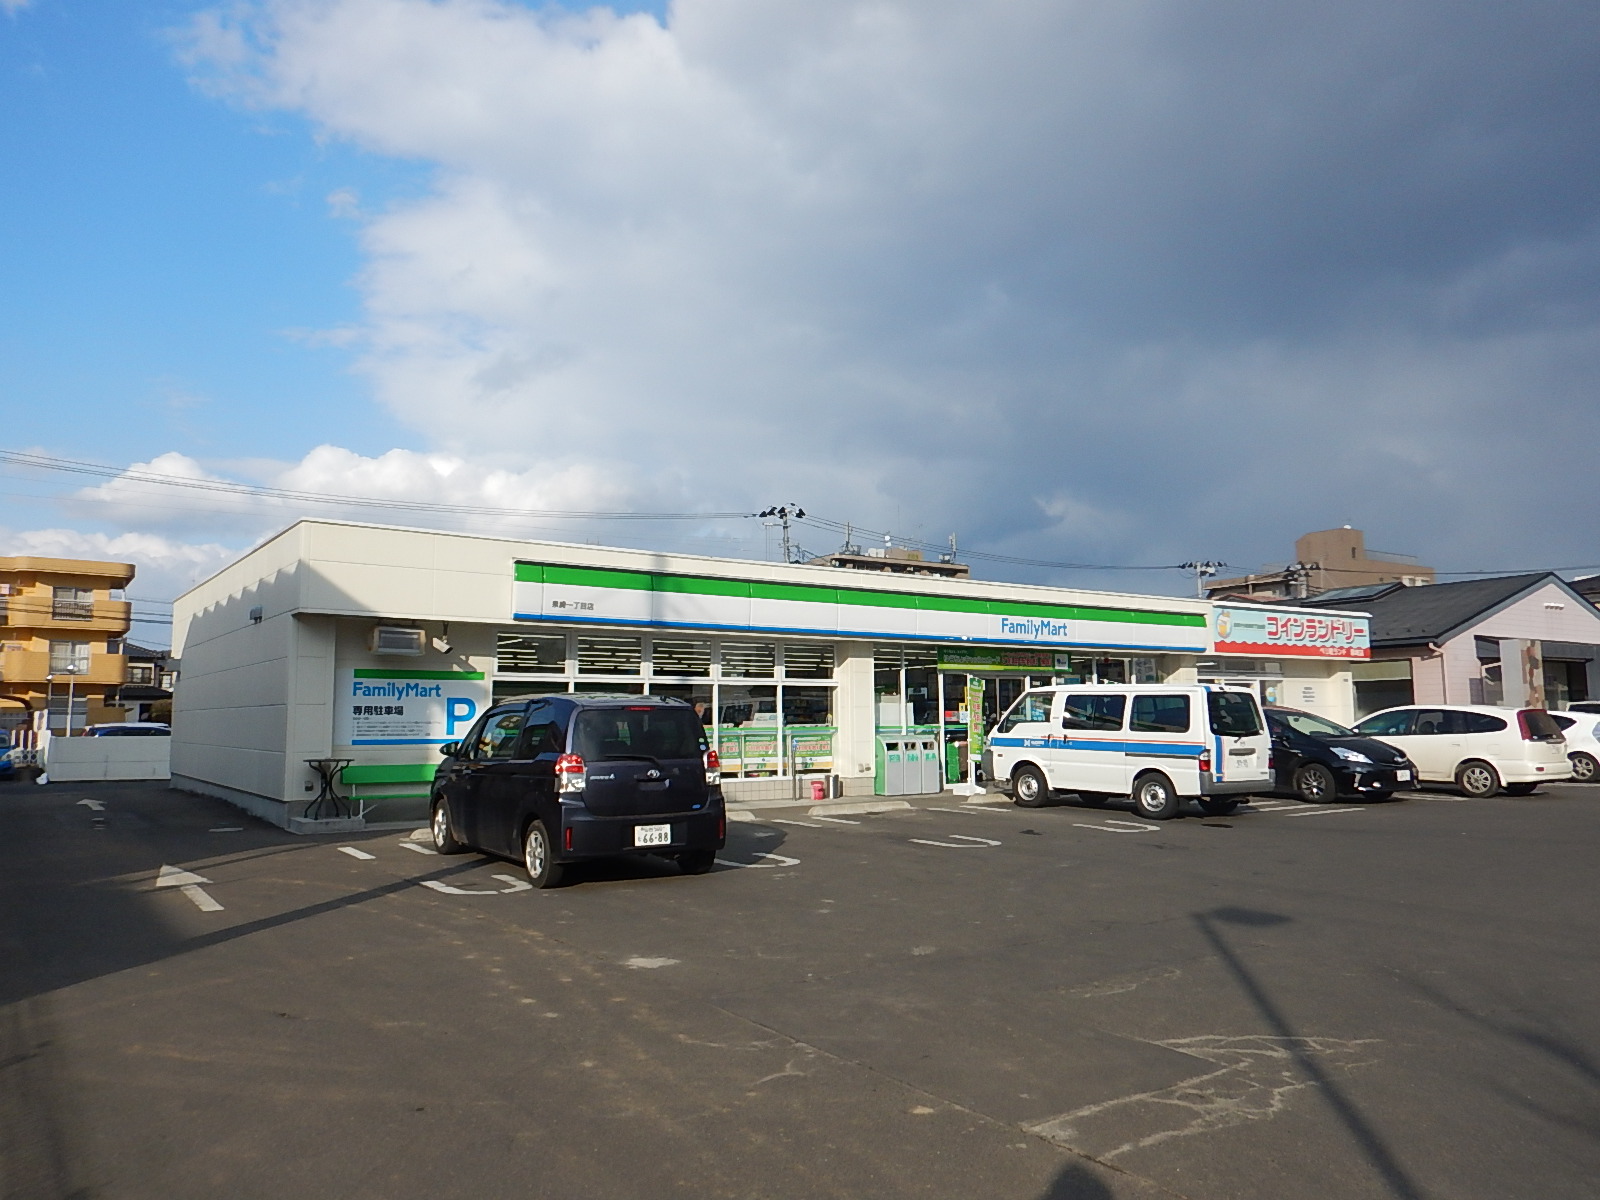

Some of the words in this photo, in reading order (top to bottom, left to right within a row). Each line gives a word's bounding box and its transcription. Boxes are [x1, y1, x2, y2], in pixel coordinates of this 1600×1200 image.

[1001, 618, 1068, 639] FamilyMart
[1266, 616, 1366, 643] コインランドリー
[352, 682, 441, 700] FamilyMart
[352, 705, 404, 716] 専用駐車場
[446, 697, 476, 735] P
